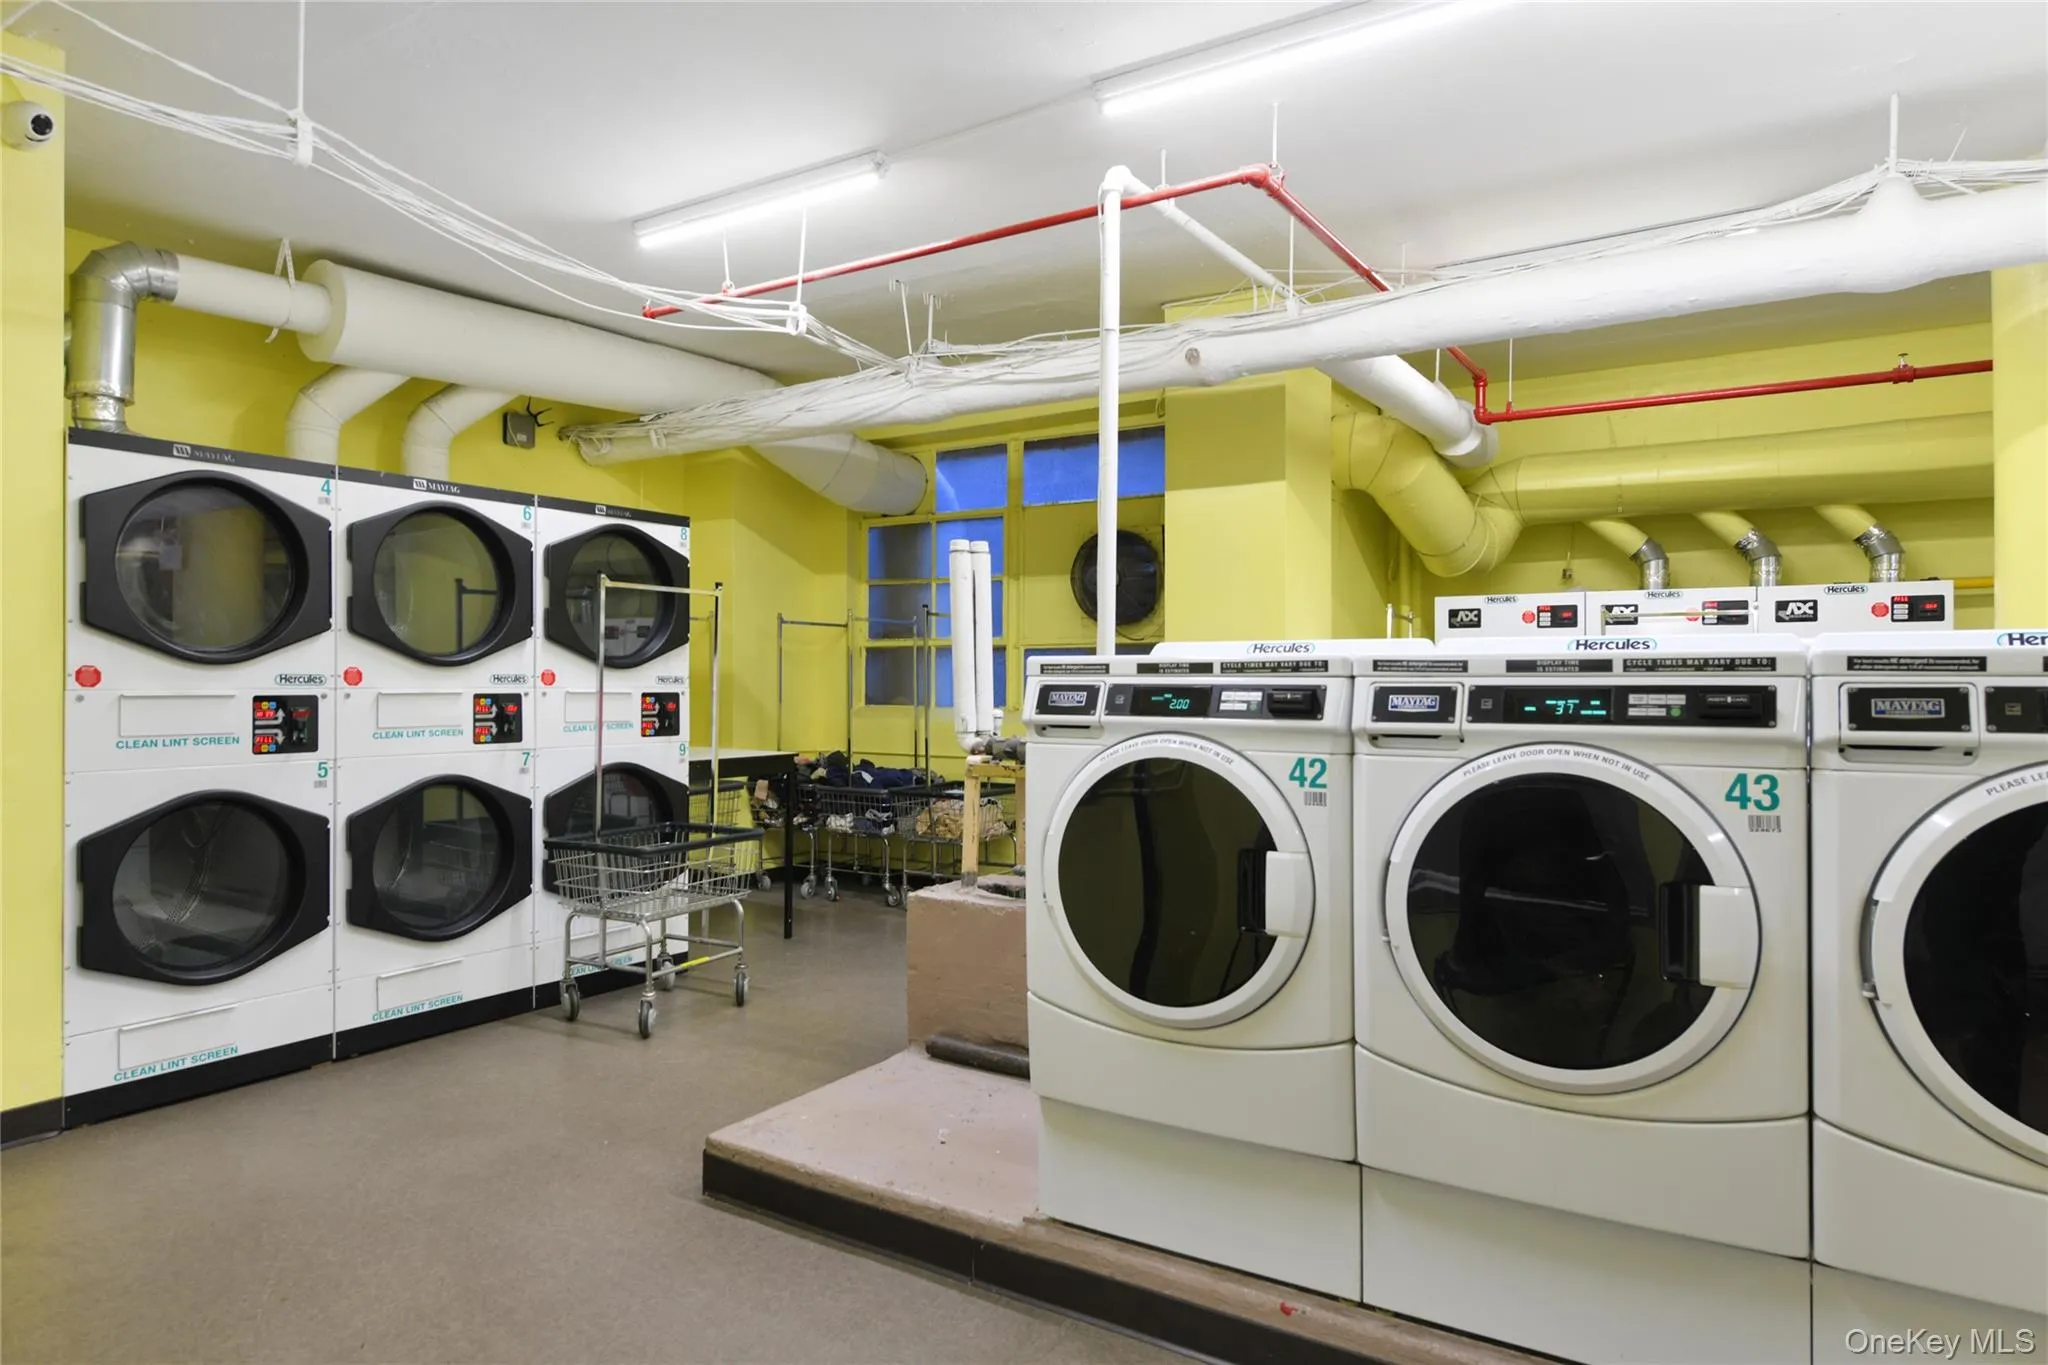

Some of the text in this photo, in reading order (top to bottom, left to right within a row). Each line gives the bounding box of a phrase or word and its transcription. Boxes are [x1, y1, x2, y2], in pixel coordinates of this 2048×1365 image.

[321, 478, 332, 496] 4
[428, 482, 461, 494] MAYTAG
[522, 506, 532, 521] 6
[680, 527, 688, 541] 8
[1827, 585, 1865, 593] Hercules
[1486, 595, 1517, 603] Hercules
[1252, 642, 1310, 654] Hercules
[1576, 638, 1651, 651] Hercules
[1626, 659, 1652, 667] CYCLE
[279, 674, 323, 685] Hercules
[492, 674, 526, 684] Hercules
[1051, 692, 1085, 701] MAYTAG
[1391, 696, 1436, 706] MAYTAG
[1555, 703, 1574, 715] 37
[1875, 700, 1940, 711] MAYTAG
[372, 728, 464, 740] CLEAN LINT SCREEN
[563, 725, 588, 733] CLEAN
[606, 722, 634, 730] SCREEN
[116, 736, 241, 750] CLEAN LINT SCREEN
[680, 743, 687, 756] 9
[522, 752, 530, 766] 7
[1463, 748, 1650, 782] PLEASE LEAVE DOOR OPEN WHEN NOT IN USE
[317, 761, 329, 778] 5
[1288, 757, 1328, 789] 42
[1724, 773, 1780, 811] 43
[1985, 775, 2029, 797] PLEASE
[372, 995, 464, 1021] CLEAN LINT SCREEN
[114, 1045, 239, 1082] CLEAN LINT SCREEN
